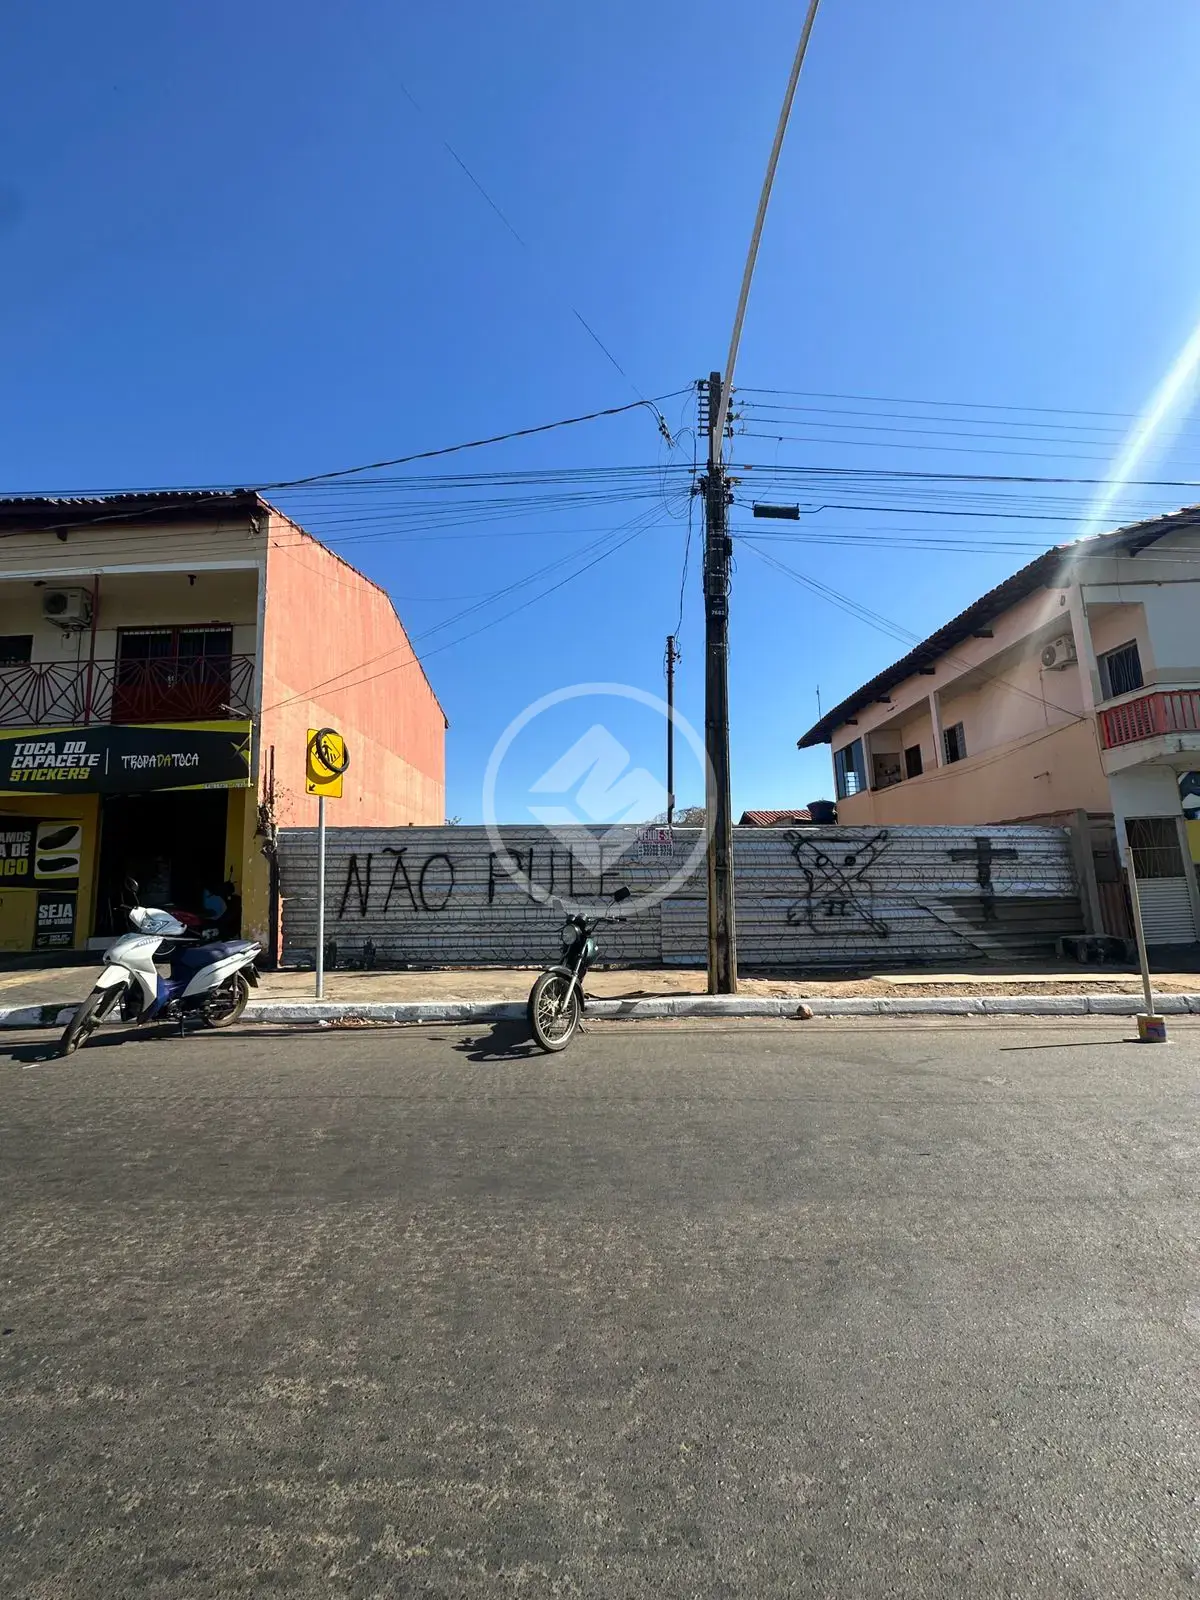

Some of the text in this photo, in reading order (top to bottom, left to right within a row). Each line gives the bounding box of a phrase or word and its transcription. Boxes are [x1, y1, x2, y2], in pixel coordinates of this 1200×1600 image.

[14, 741, 87, 755] TOCA DO
[10, 753, 101, 768] CAPACETE
[9, 767, 90, 782] STICKERS
[11, 843, 30, 857] DE
[338, 846, 455, 920] NÃO
[38, 903, 73, 919] SEJA
